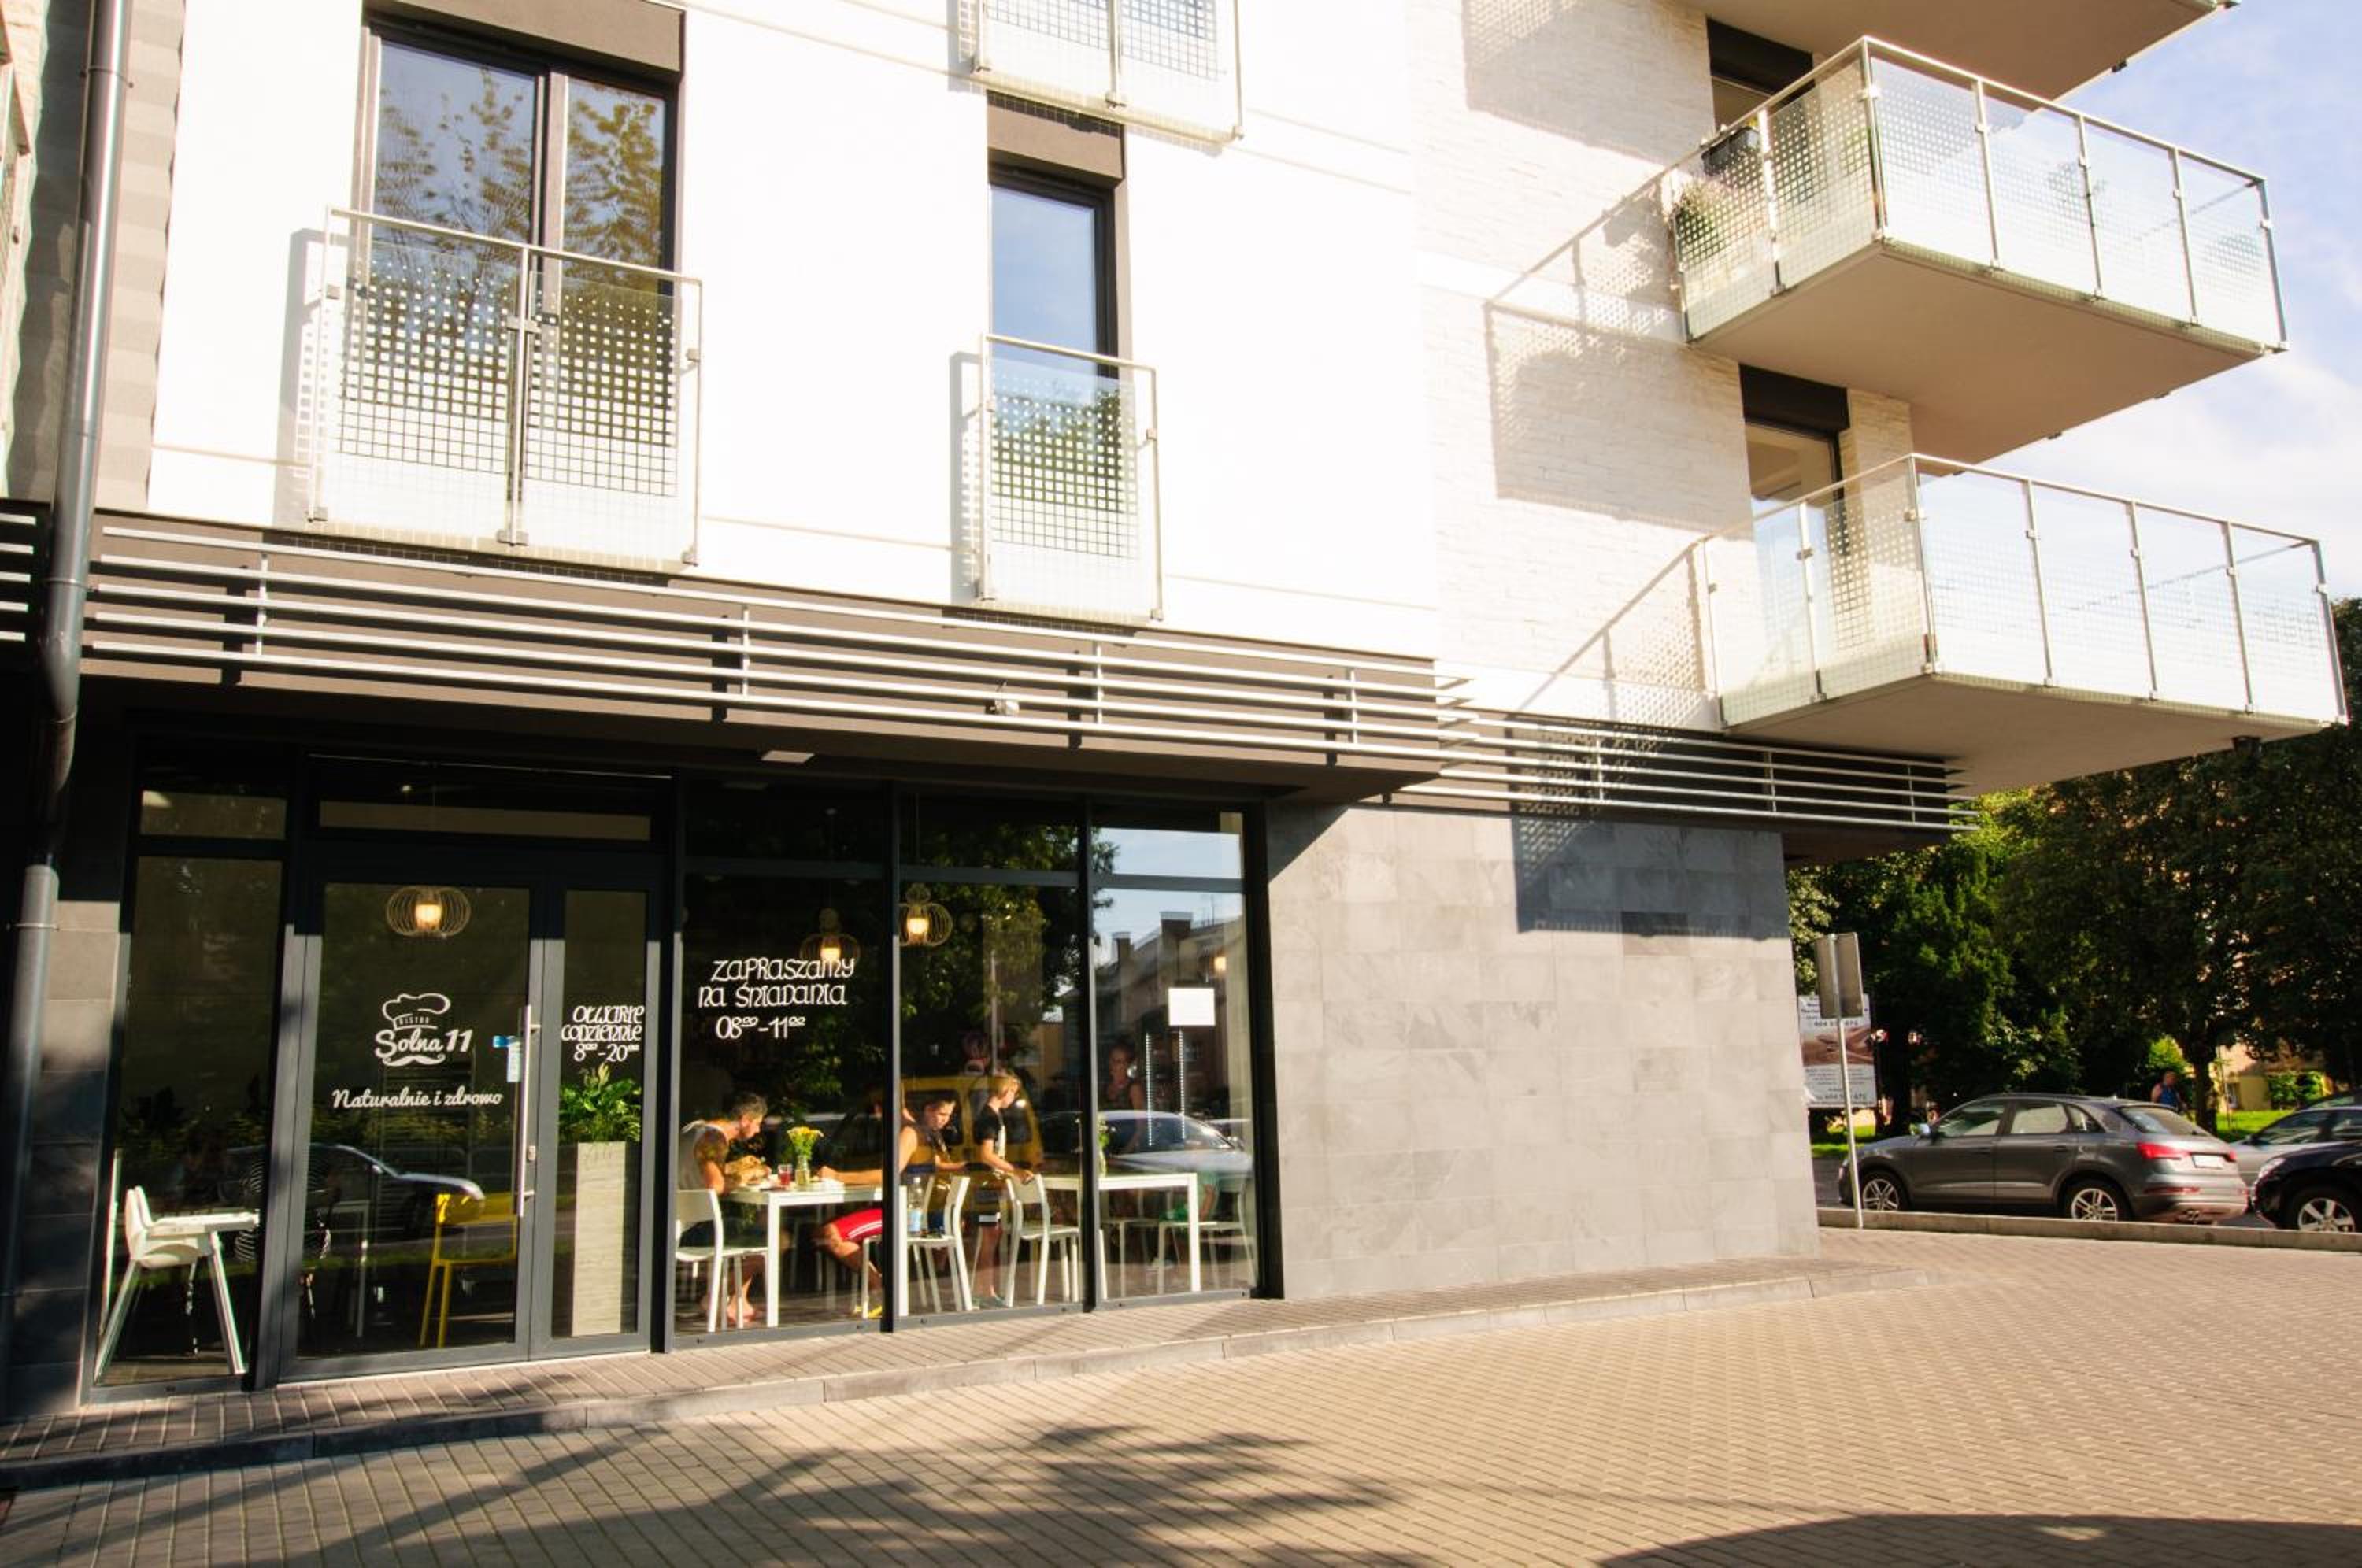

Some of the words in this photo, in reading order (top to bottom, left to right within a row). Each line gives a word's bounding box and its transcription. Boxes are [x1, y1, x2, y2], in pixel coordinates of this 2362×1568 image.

[698, 986, 727, 1008] na
[375, 1026, 444, 1058] Solna
[445, 1029, 473, 1052] 11
[331, 1085, 431, 1108] Naturalnie
[432, 1090, 442, 1106] i
[444, 1085, 504, 1106] zdrowo
